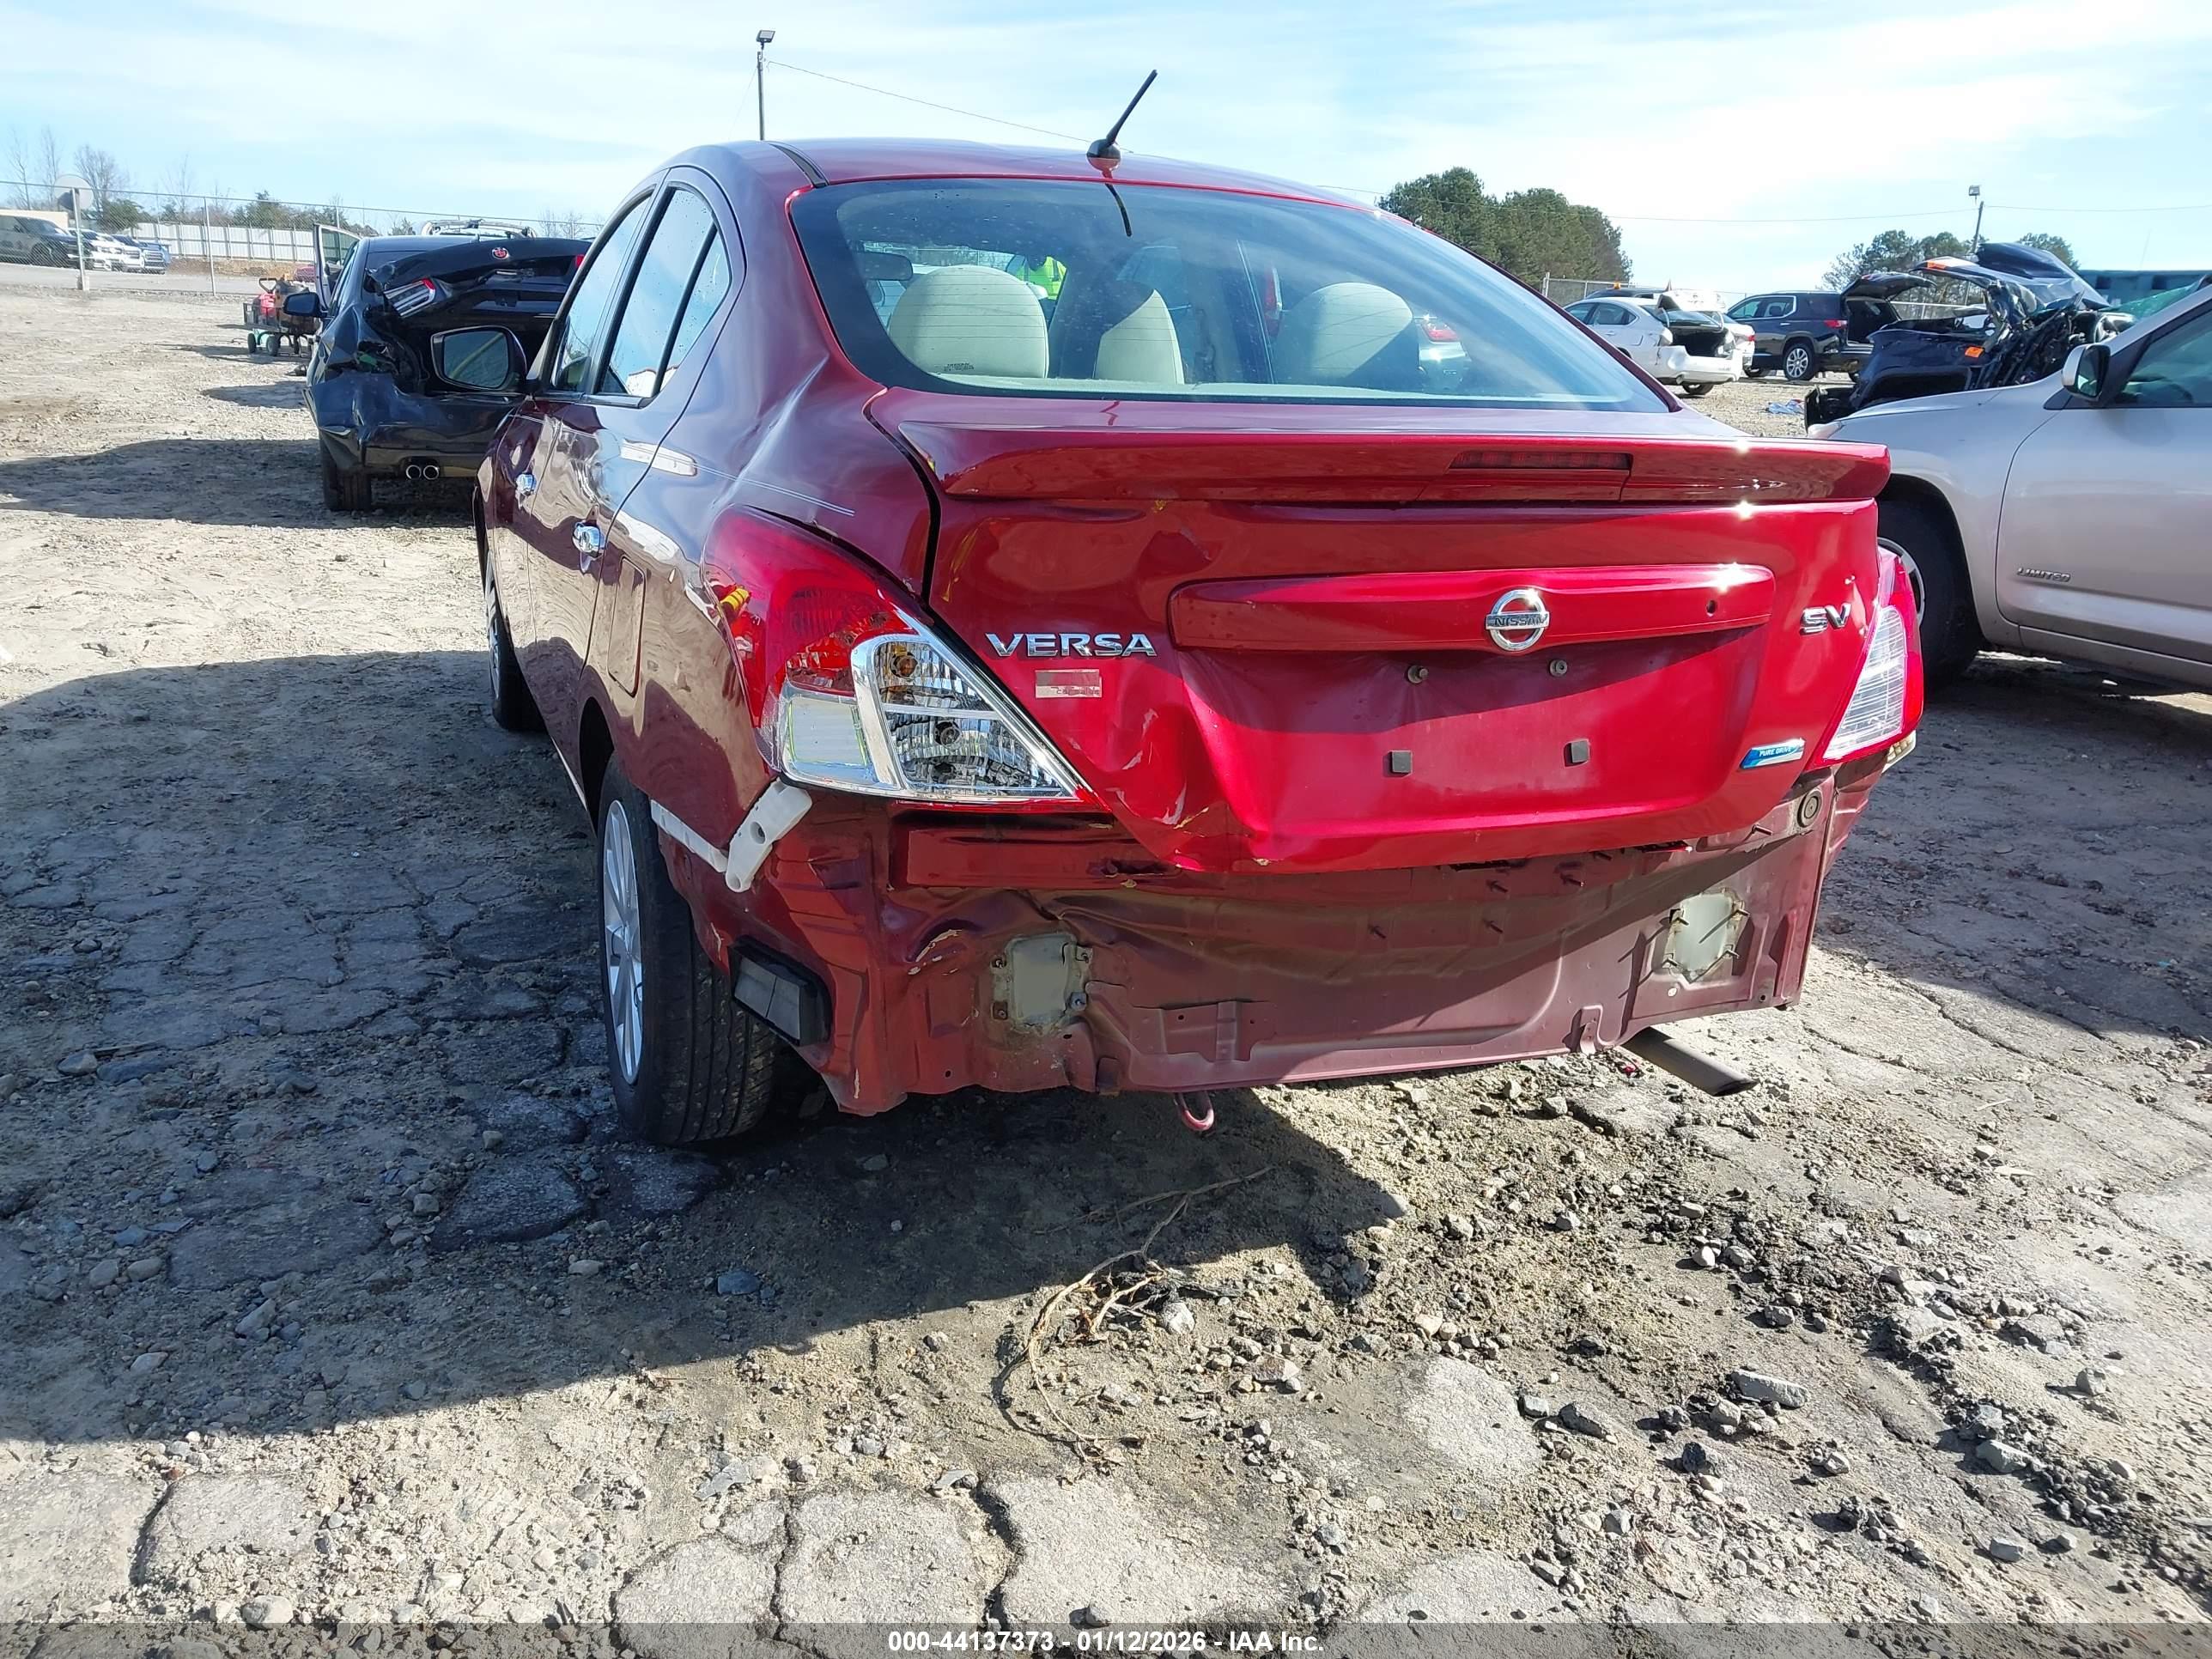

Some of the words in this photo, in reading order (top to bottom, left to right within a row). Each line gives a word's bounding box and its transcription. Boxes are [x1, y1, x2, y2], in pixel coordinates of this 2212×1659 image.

[2016, 567, 2071, 583] LIMITED
[1494, 613, 1548, 628] NISSAN
[1800, 603, 1852, 635] SV
[985, 632, 1158, 658] VERSA
[1759, 748, 1775, 757] PURE
[1775, 746, 1792, 755] DRIVE
